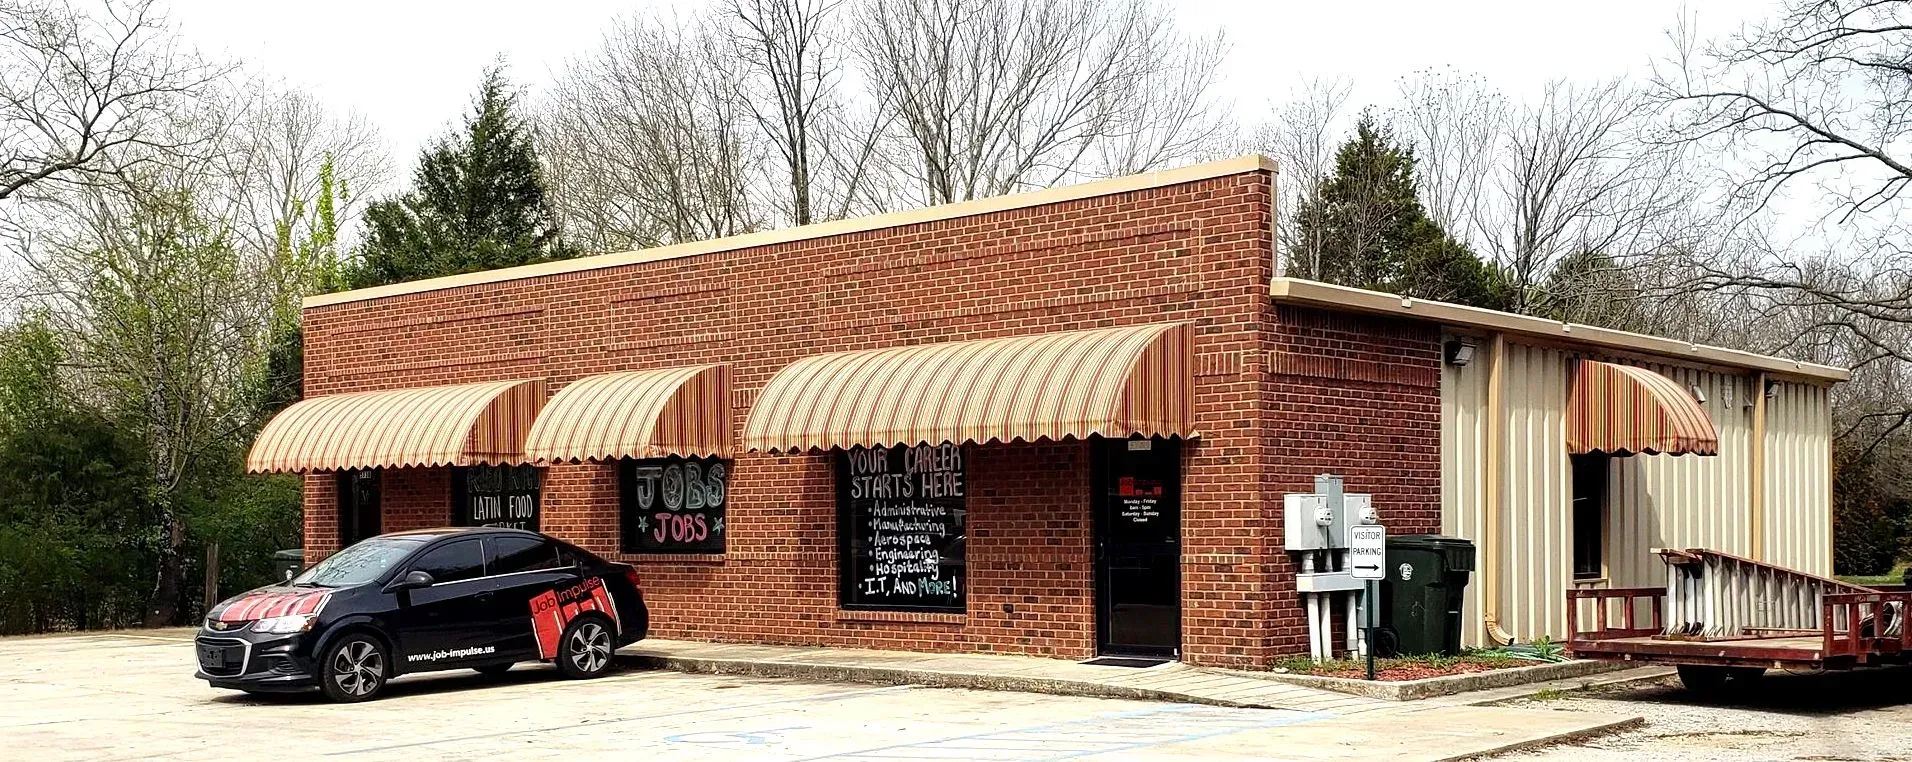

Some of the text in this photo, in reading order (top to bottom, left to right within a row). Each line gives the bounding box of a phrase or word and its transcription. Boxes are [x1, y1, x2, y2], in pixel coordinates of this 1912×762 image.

[847, 443, 961, 476] YOUR CAREER
[636, 462, 725, 511] JOBS
[851, 471, 964, 499] STARTS HERE
[473, 494, 533, 520] LATIN FOOD
[873, 500, 946, 517] Administrative
[653, 513, 707, 543] JOBS
[873, 518, 945, 538] Manufacturing
[1353, 531, 1381, 540] VISITOR
[874, 531, 931, 551] Aerospace
[875, 547, 939, 564] Engineering
[1352, 547, 1381, 556] PARKING
[876, 559, 939, 580] Hospitality
[534, 576, 601, 615] Job Impulse
[893, 578, 917, 595] AND
[408, 646, 495, 662] www.job-impulse.us
